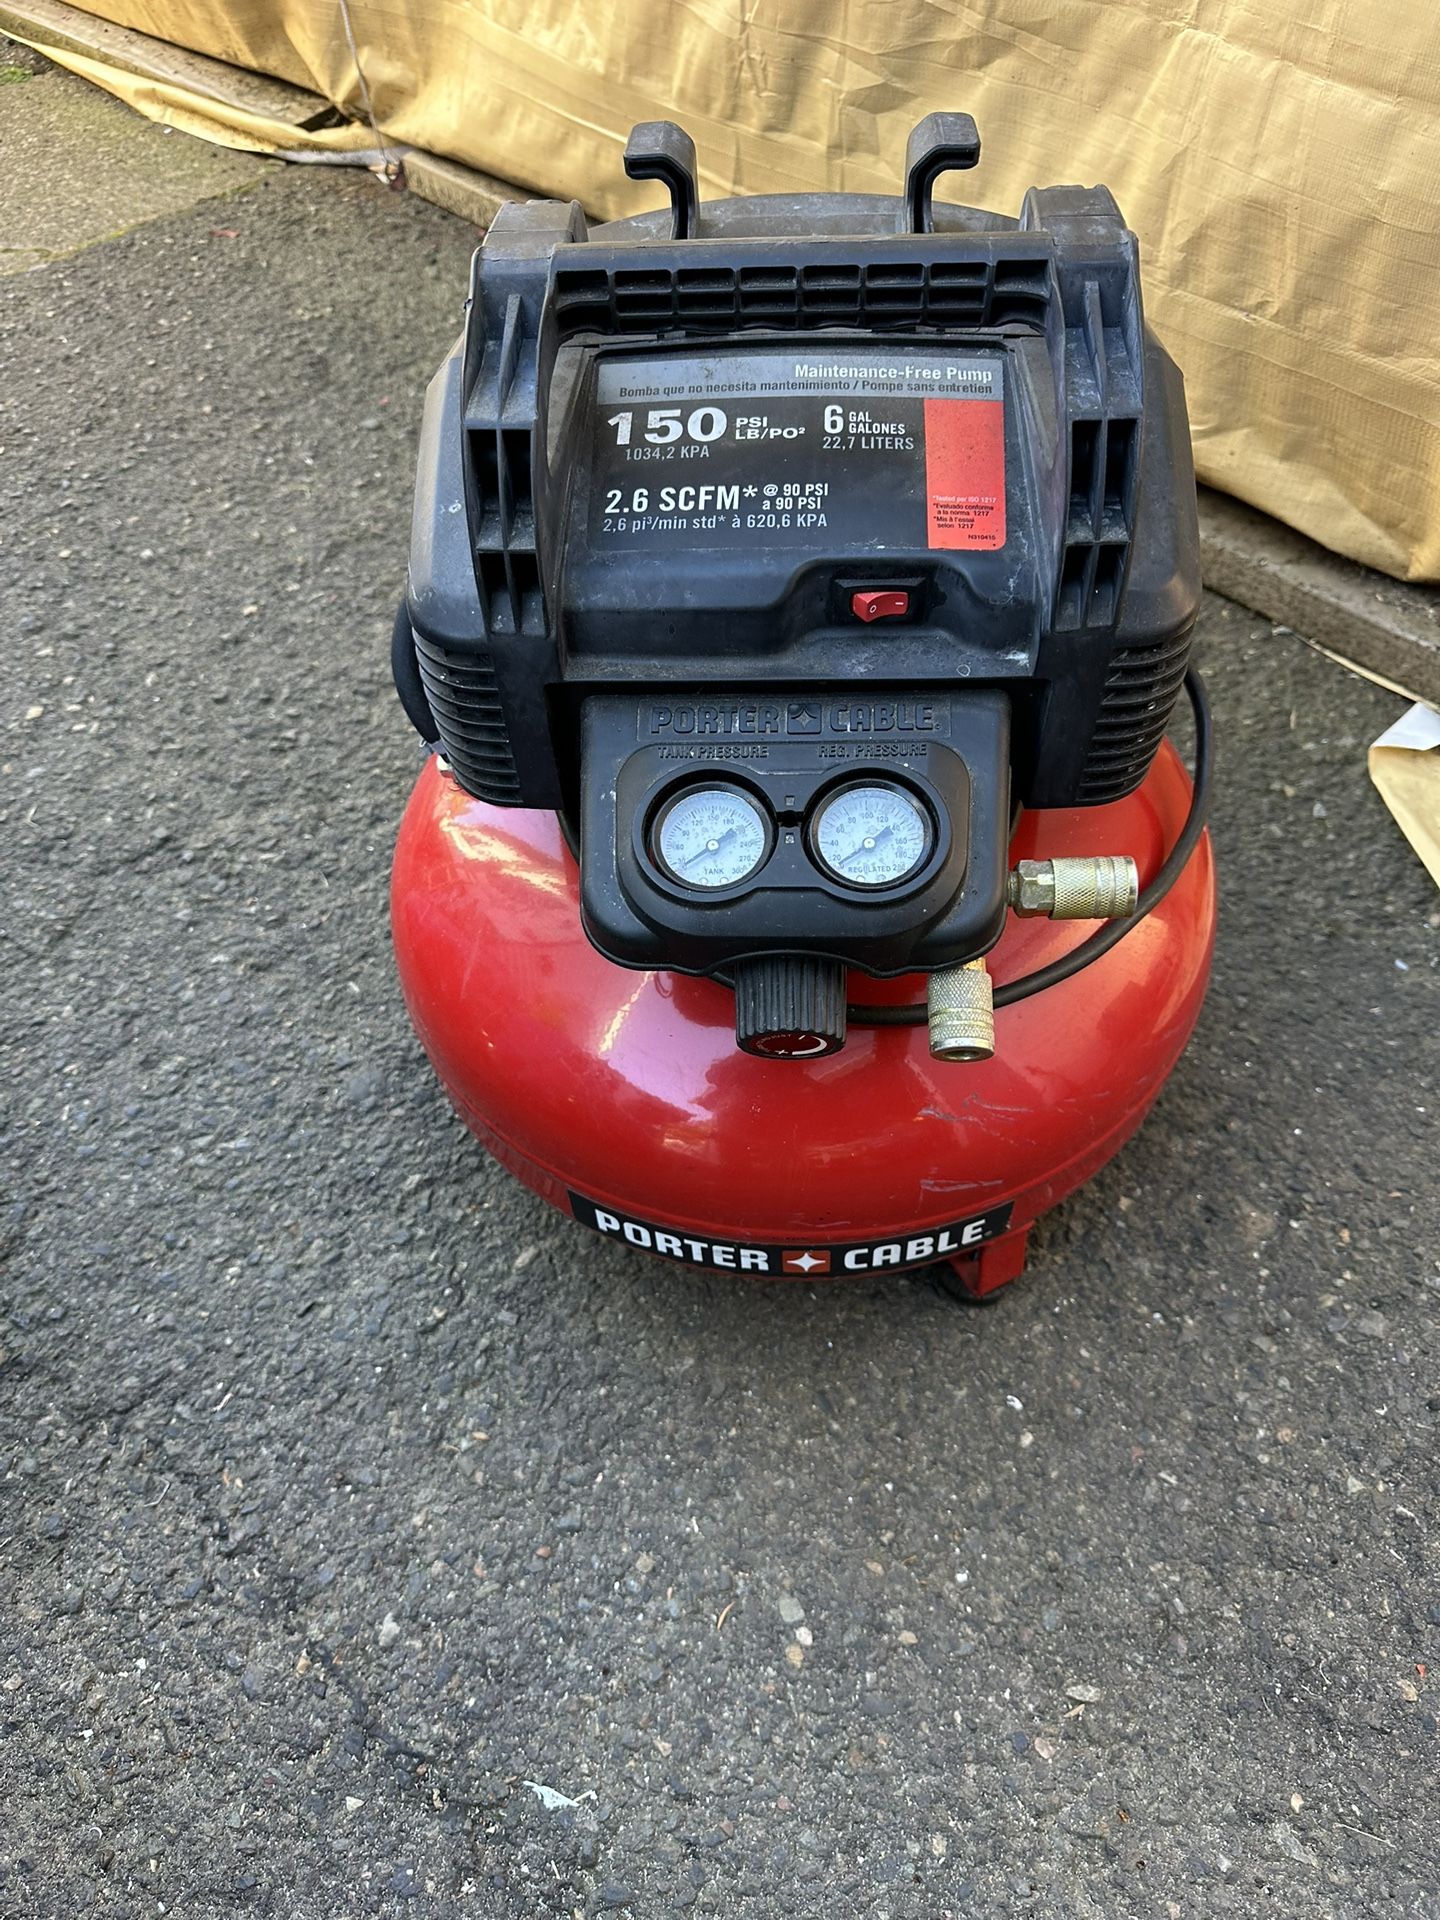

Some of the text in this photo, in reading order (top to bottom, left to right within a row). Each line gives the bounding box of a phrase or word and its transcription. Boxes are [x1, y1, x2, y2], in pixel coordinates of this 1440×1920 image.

[795, 364, 992, 383] Maintenance-Free Pump
[620, 380, 992, 397] Bomba que no necesita mantenimiento / Pompe sans entretien
[736, 416, 768, 428] PSI
[824, 404, 844, 434] 6
[849, 411, 872, 423] GAL
[607, 406, 728, 445] 150
[849, 422, 906, 435] GALONES
[822, 436, 914, 451] 22,7 LITERS
[625, 445, 710, 461] 1034,2 KPA
[763, 483, 828, 497] @ 90 PSI
[604, 488, 649, 514] 2.6
[775, 497, 794, 510] 90
[797, 497, 821, 510] PSI
[602, 517, 627, 533] 2,6
[731, 514, 741, 528] à
[746, 514, 791, 529] 620,6
[796, 513, 828, 528] KPA
[651, 703, 935, 735] PORTER CABLE
[658, 744, 769, 759] TANK PRESSURE
[855, 743, 928, 757] PRESSURE
[594, 1208, 987, 1272] PORTER CABLE
